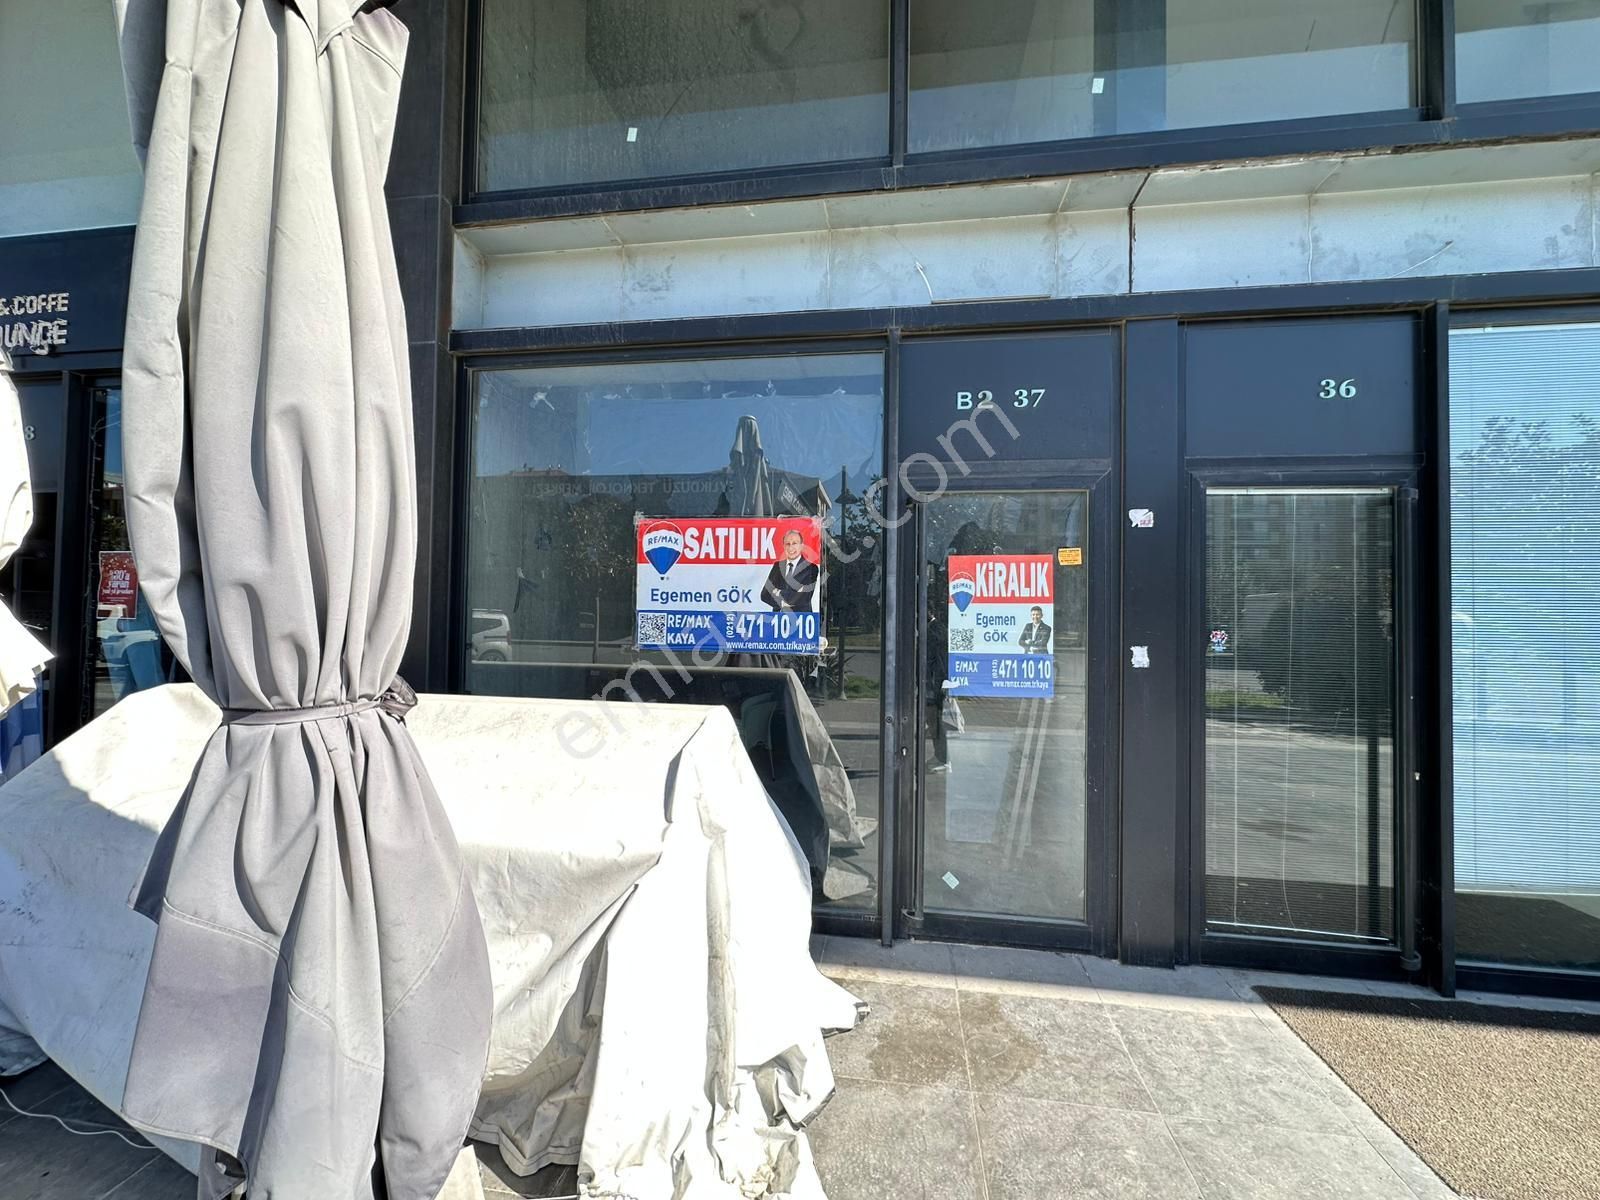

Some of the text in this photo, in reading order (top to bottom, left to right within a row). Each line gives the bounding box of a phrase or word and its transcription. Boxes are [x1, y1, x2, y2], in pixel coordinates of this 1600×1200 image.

[11, 293, 69, 315] COFFE
[1319, 378, 1357, 399] 36
[956, 388, 1046, 411] B2 37
[647, 535, 679, 546] RE/MAX
[683, 527, 777, 560] SATILIK
[650, 586, 752, 604] Egemen GÖK
[667, 615, 712, 629] RE/MAX
[726, 613, 815, 640] (0212) 471 10 10
[976, 613, 1016, 628] Egemen
[667, 633, 696, 645] KAYA
[983, 630, 1009, 642] GÖK
[999, 660, 1018, 679] 471
[1022, 660, 1035, 679] 10
[1039, 660, 1051, 680] 10
